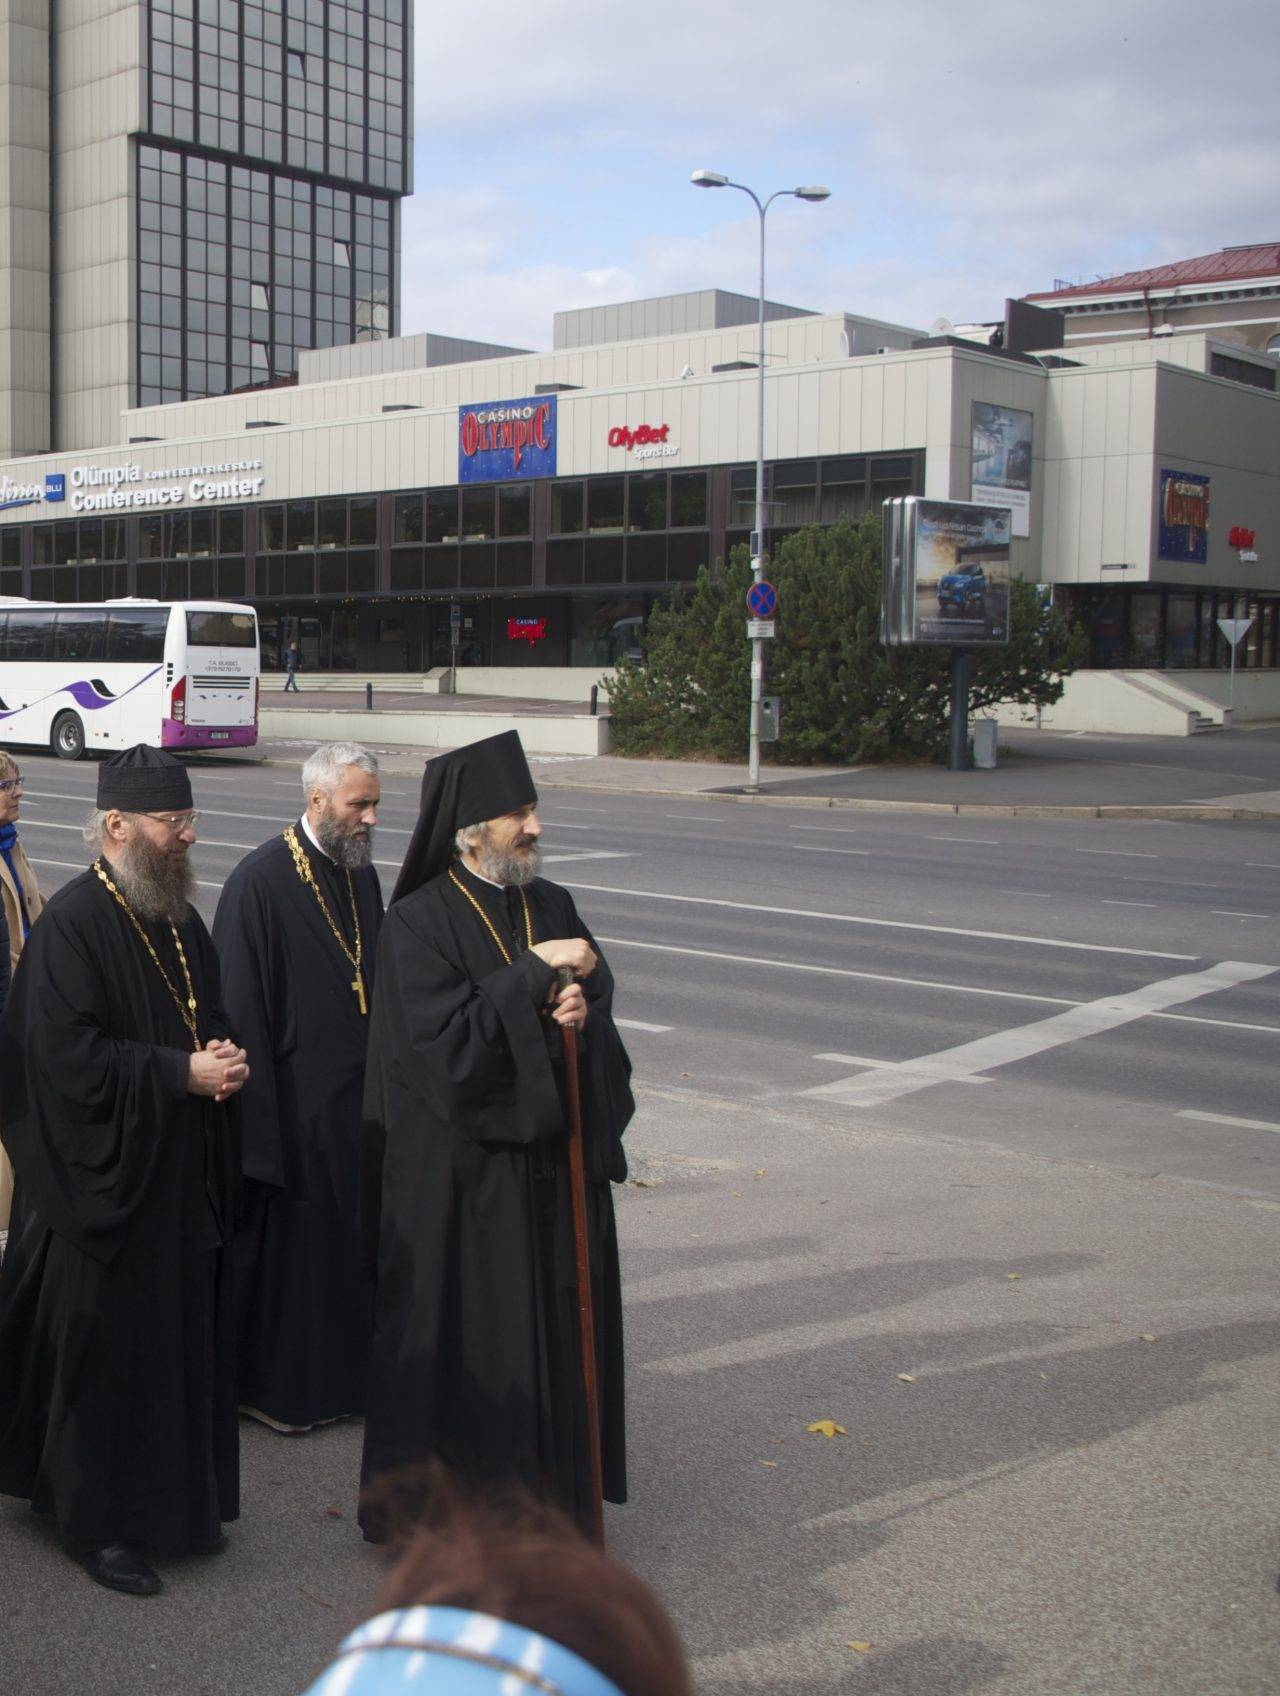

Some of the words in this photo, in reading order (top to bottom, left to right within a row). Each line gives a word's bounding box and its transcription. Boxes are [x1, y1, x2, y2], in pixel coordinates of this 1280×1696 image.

[478, 407, 532, 424] CASINO
[608, 424, 670, 451] OlyBet
[70, 463, 141, 488] Olümpia
[46, 484, 63, 493] BLU
[70, 485, 184, 512] Conference
[188, 476, 265, 501] Center
